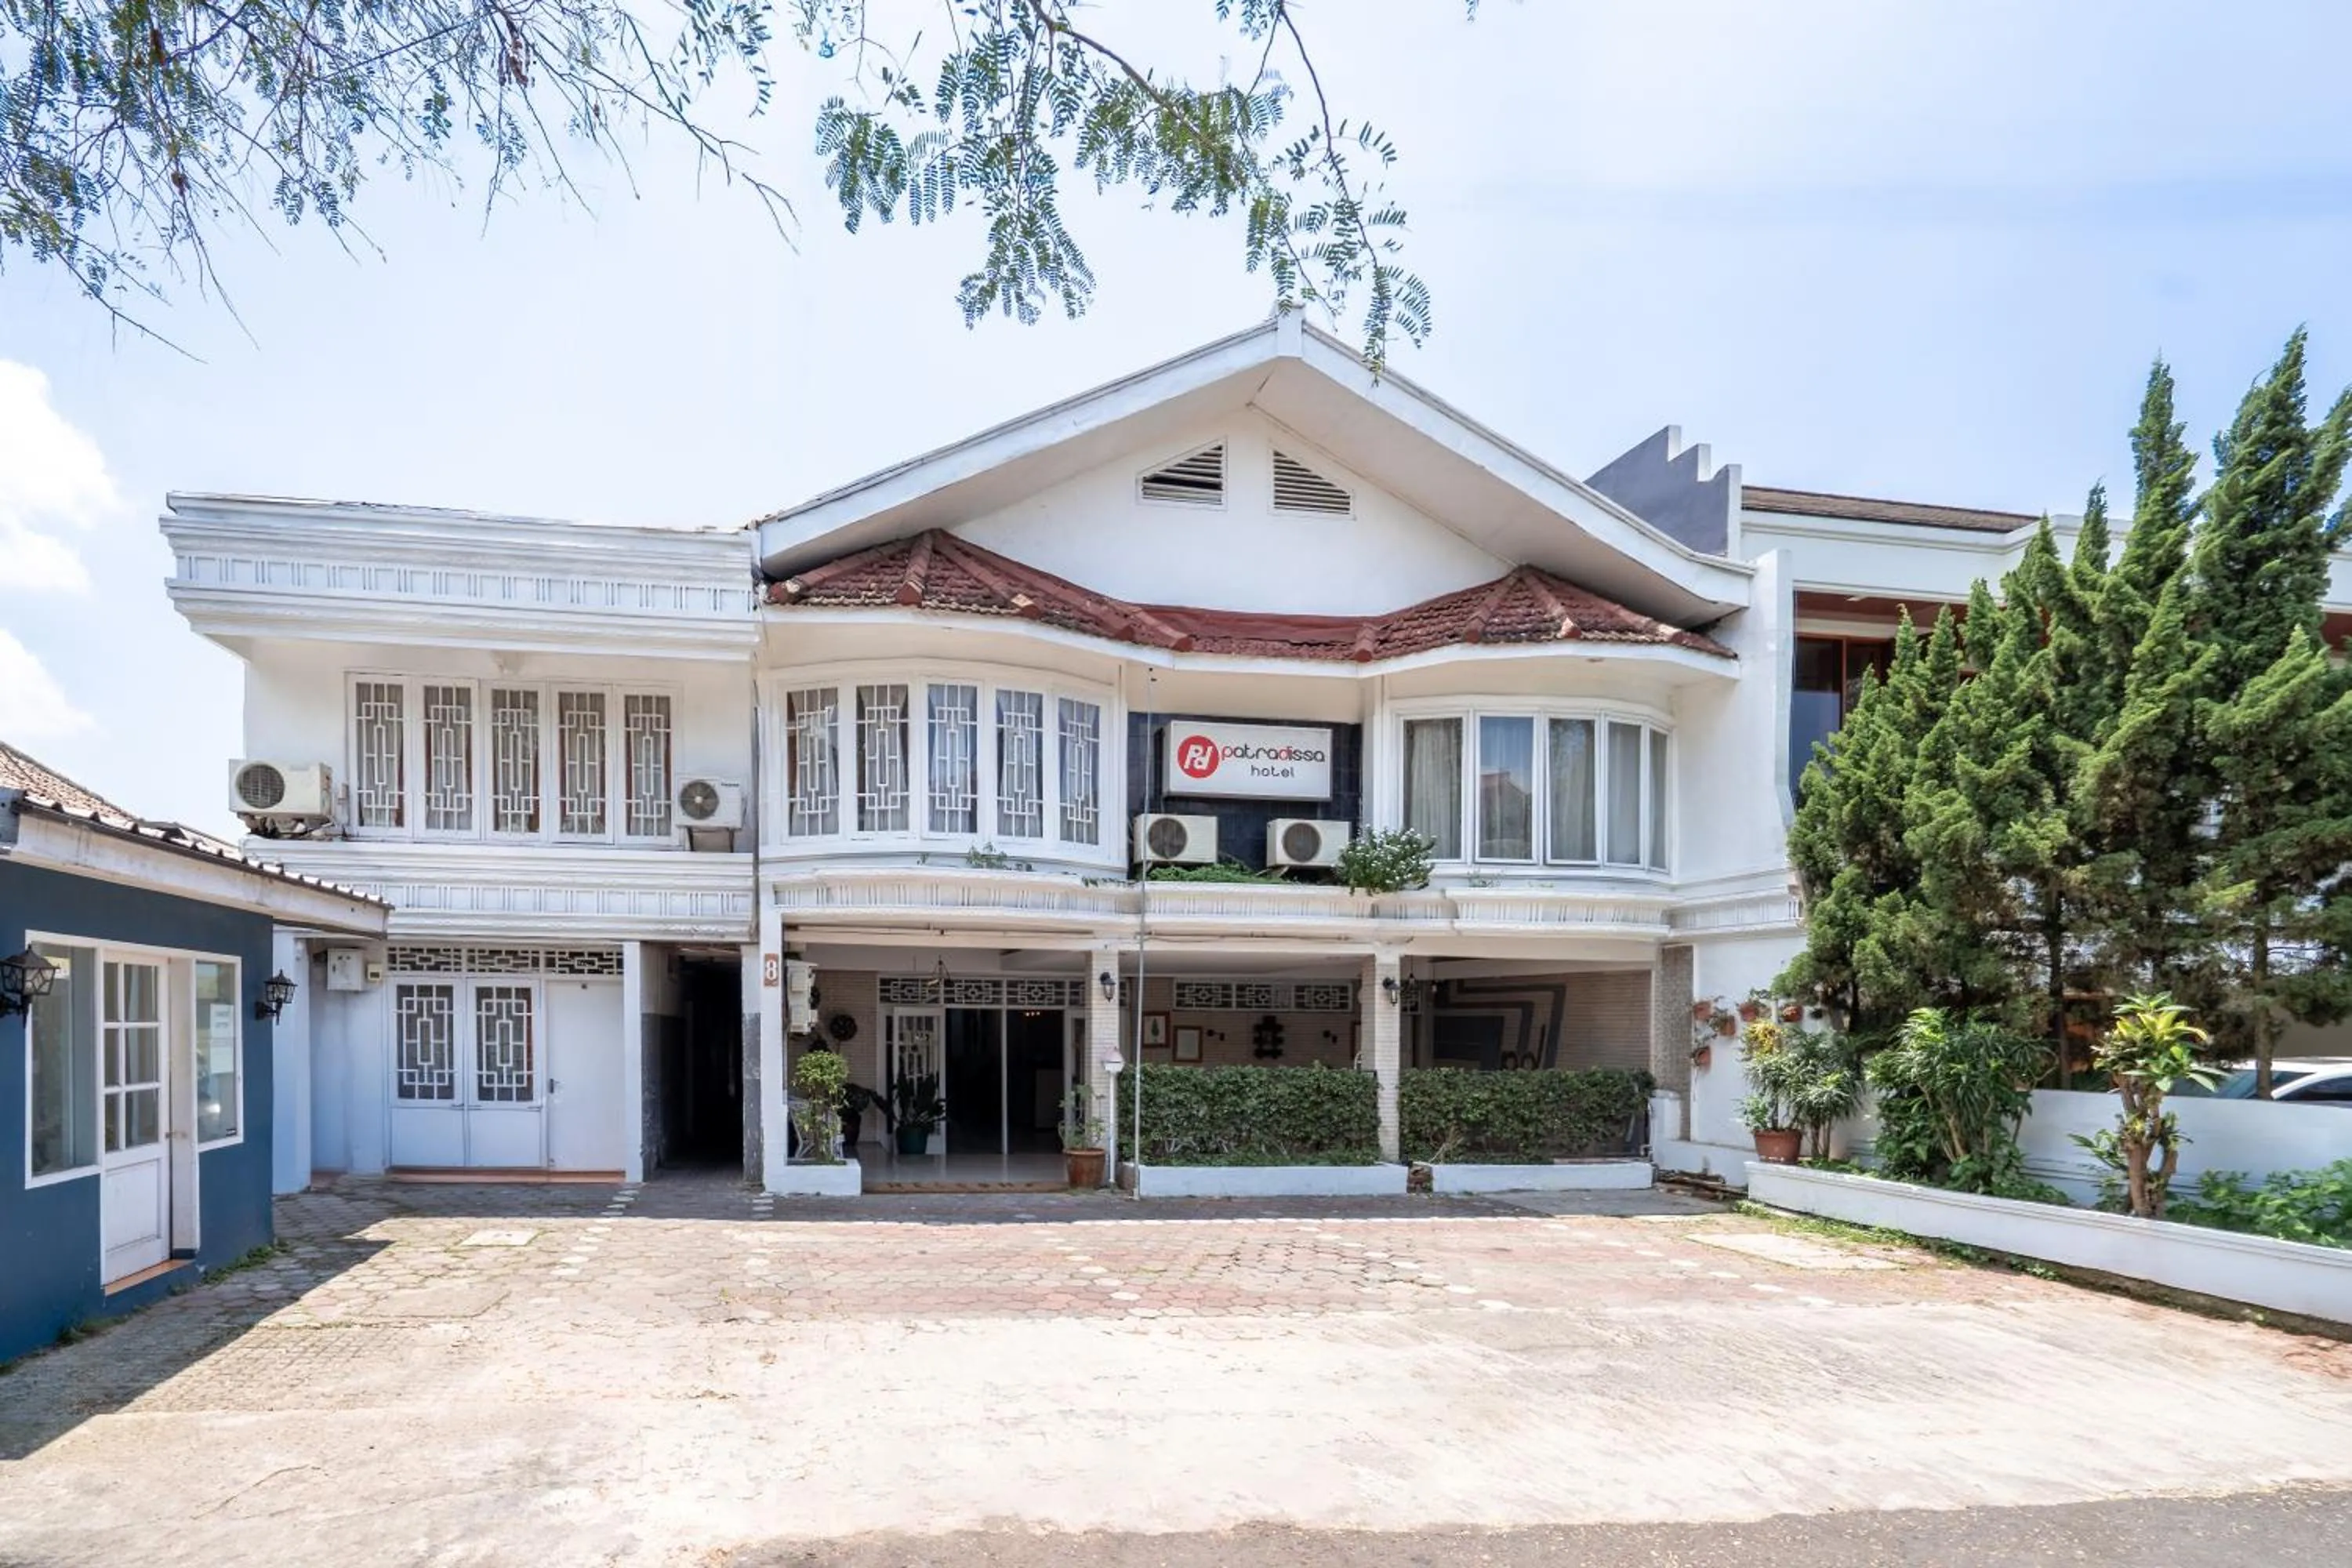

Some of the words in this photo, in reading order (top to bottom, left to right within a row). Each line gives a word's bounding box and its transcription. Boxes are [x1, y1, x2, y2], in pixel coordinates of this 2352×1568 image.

[1221, 743, 1326, 763] patradissa
[1250, 764, 1294, 778] hotel
[766, 960, 777, 981] 8
